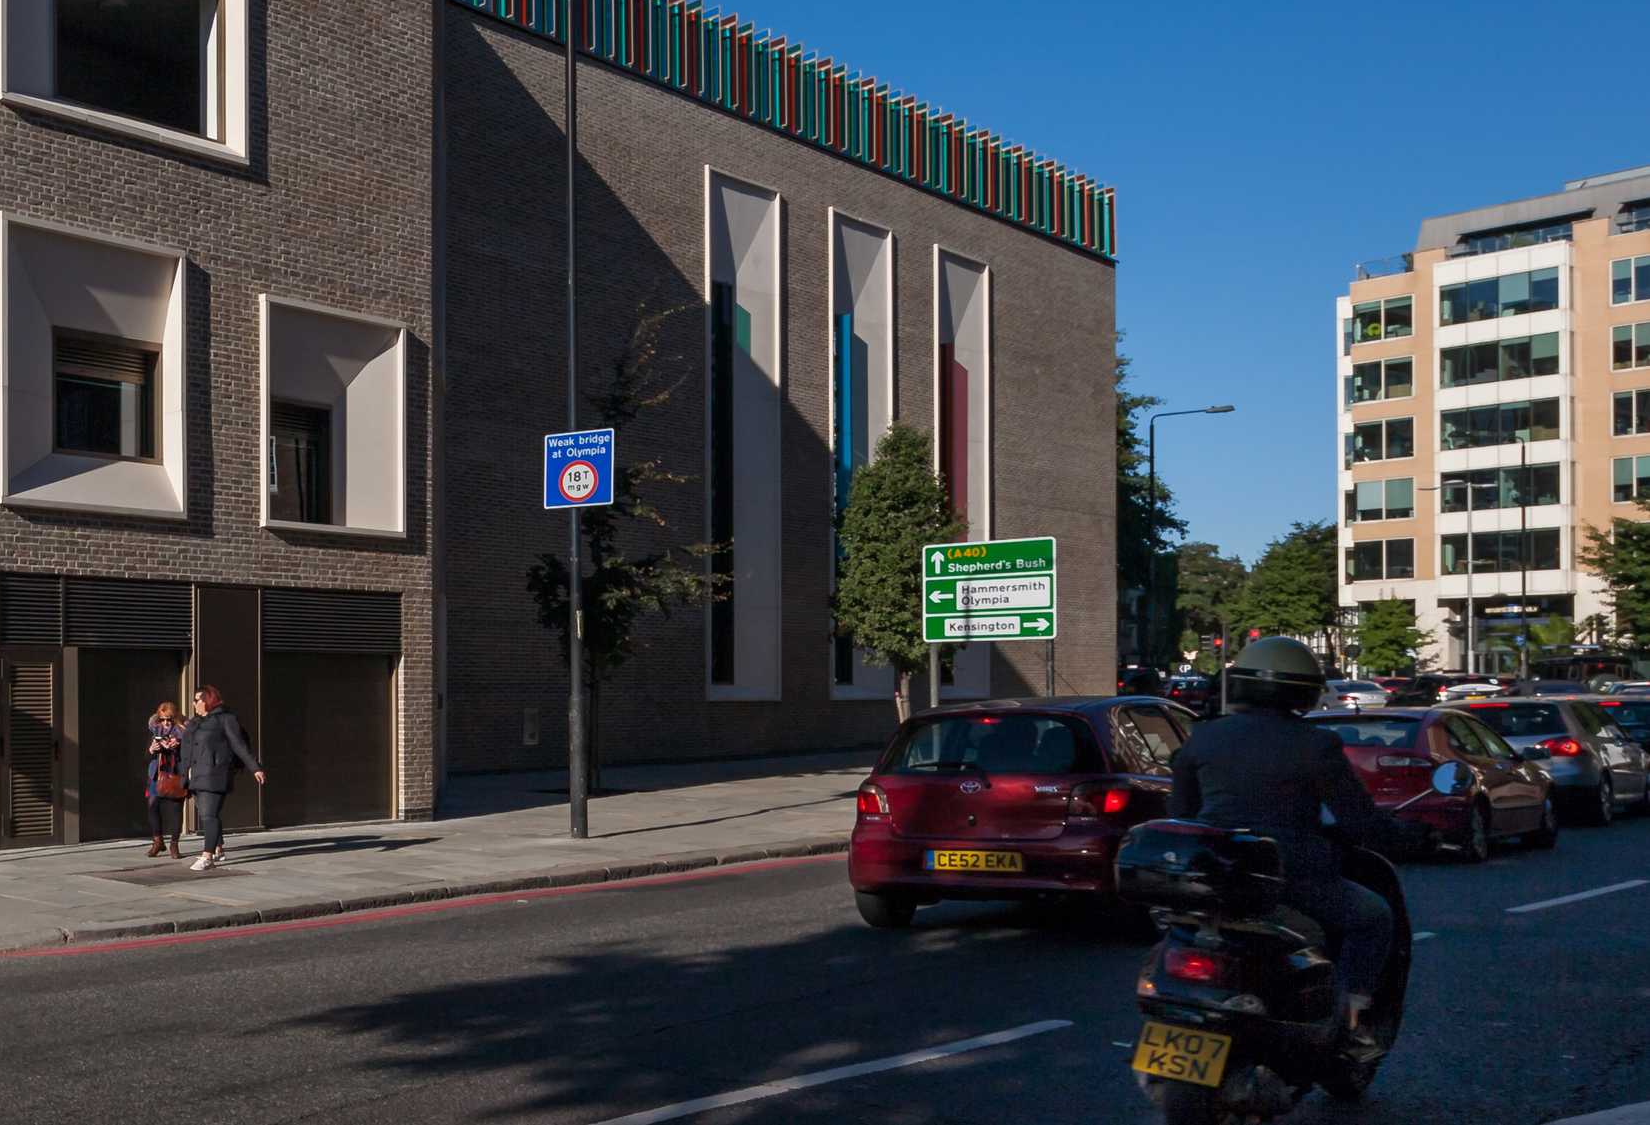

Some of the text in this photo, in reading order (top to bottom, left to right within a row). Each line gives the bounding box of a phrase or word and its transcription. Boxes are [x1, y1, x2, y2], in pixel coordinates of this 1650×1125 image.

[548, 434, 611, 448] Weak bridge
[552, 446, 606, 459] at Olympia
[948, 558, 1046, 574] Shepherd's Bush
[961, 582, 1046, 595] Hammersmith
[961, 596, 1010, 607] Olympia
[949, 621, 1015, 633] Kensington
[937, 853, 1018, 869] CE52 EKA
[1147, 1049, 1209, 1080] KSN
